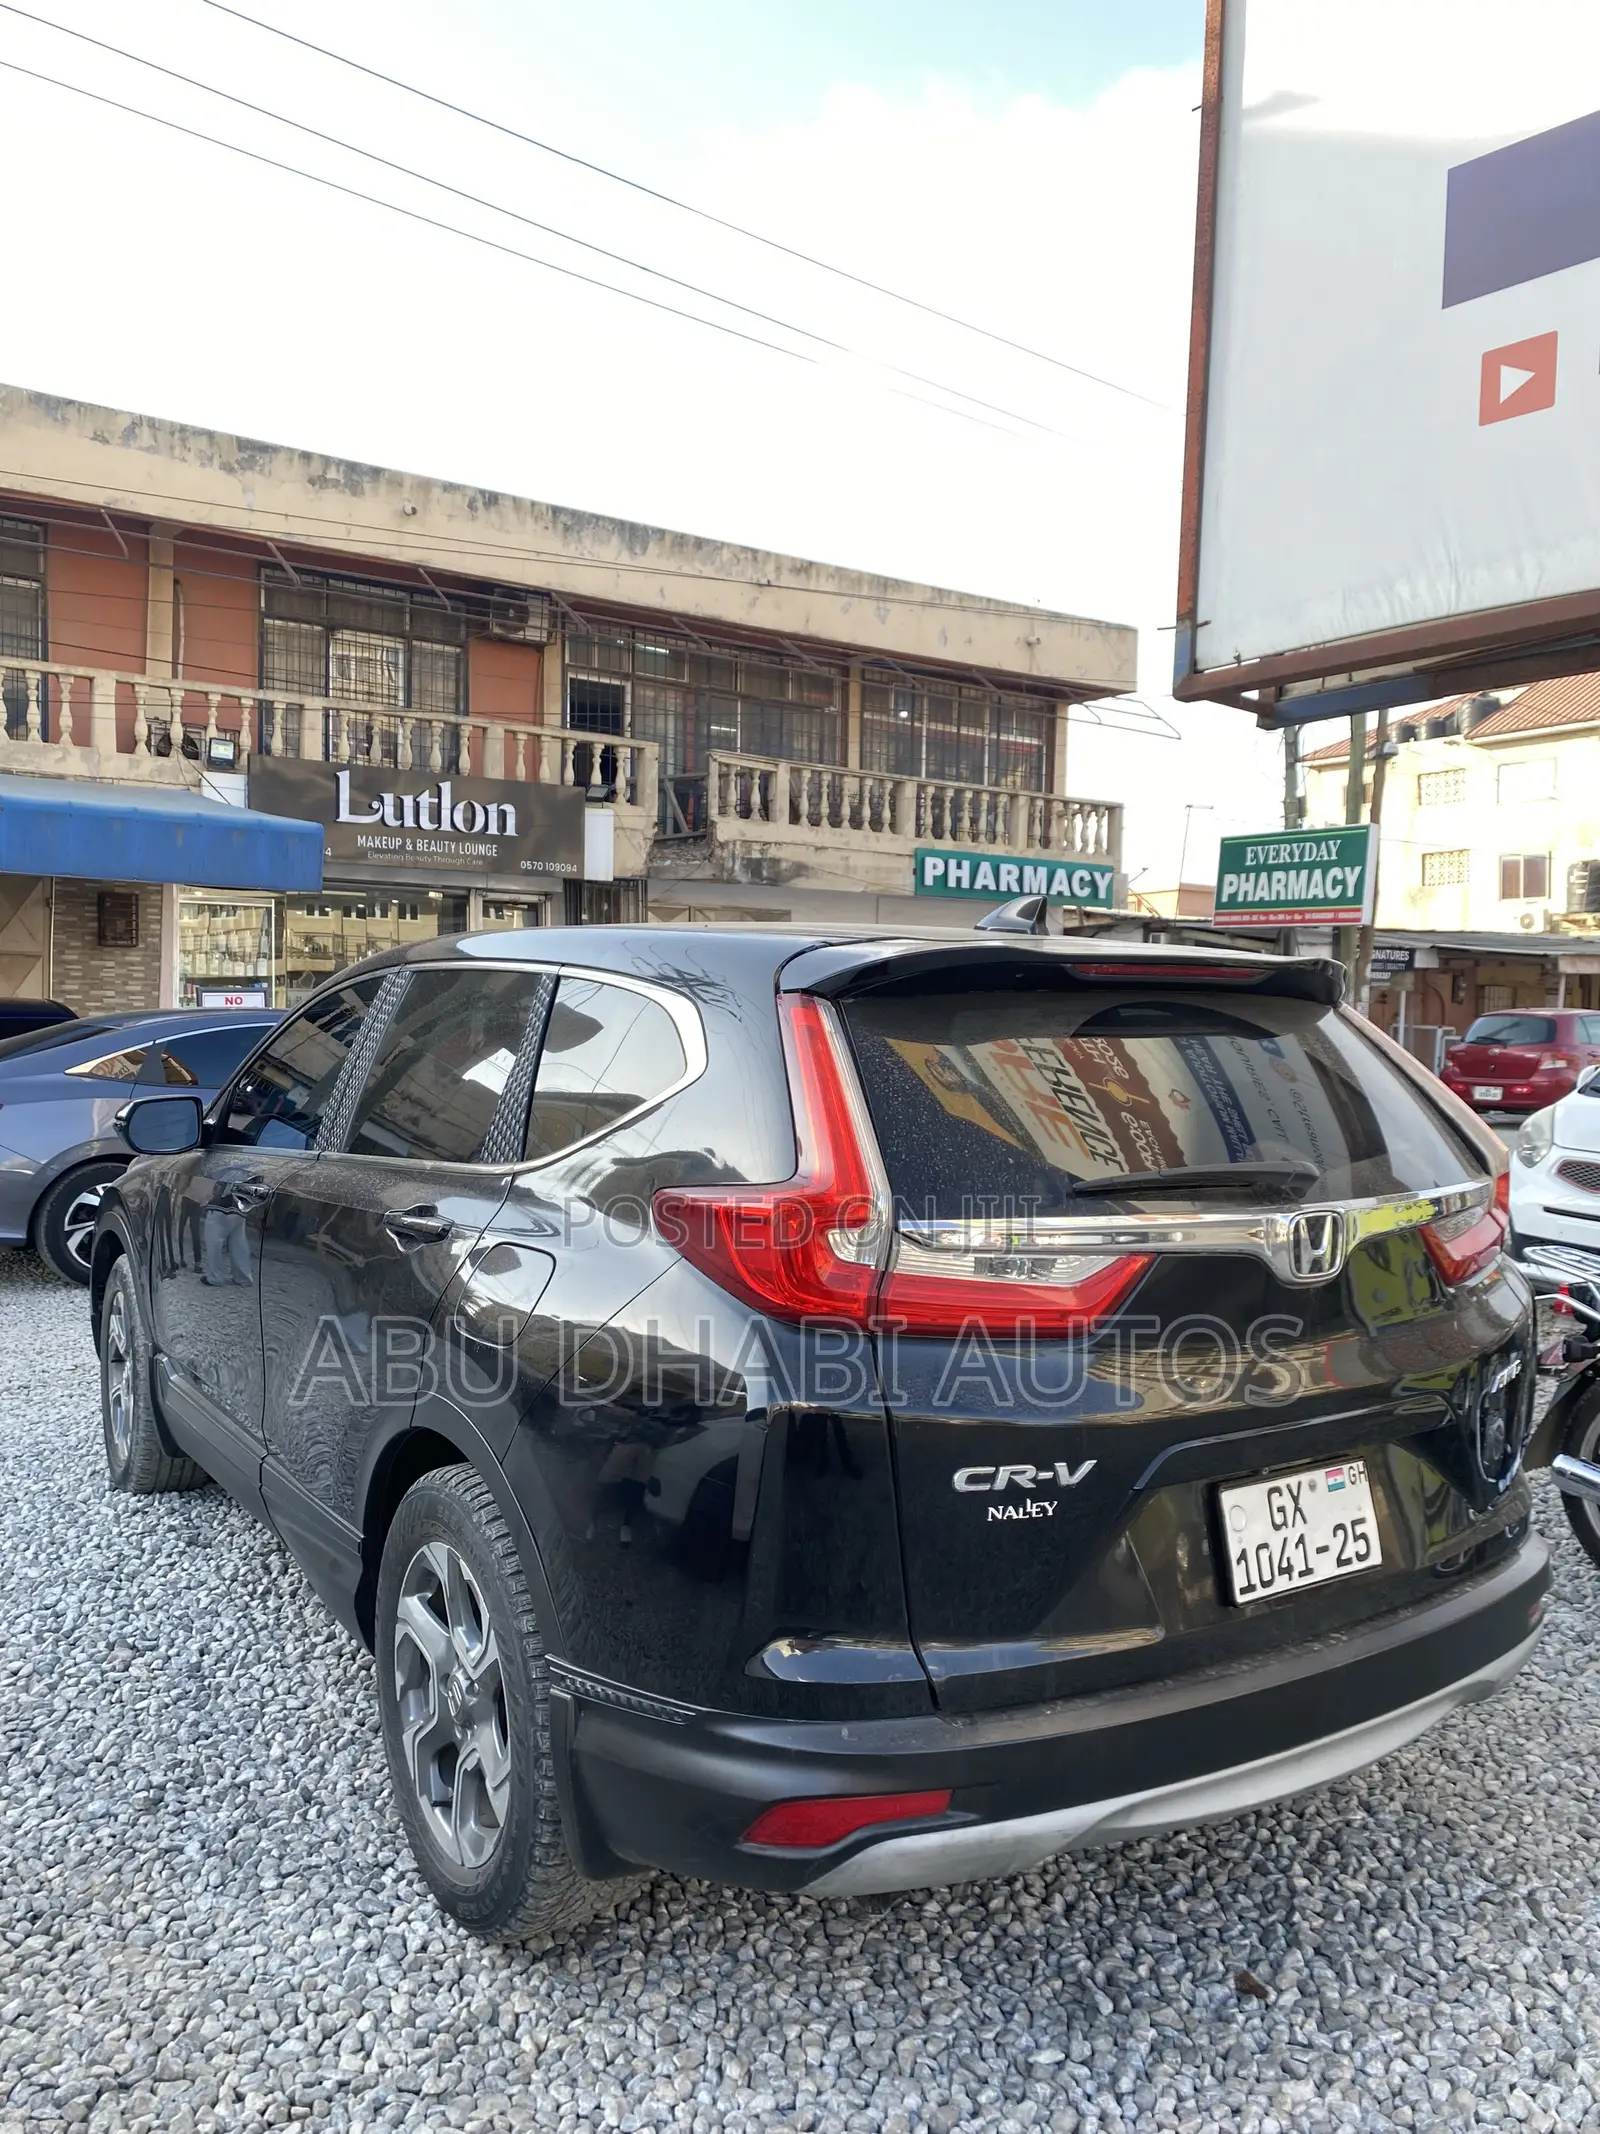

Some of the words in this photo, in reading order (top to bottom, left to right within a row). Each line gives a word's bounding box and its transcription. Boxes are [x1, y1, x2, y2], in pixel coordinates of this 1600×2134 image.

[335, 770, 519, 837] Lutlon
[357, 834, 402, 850] MAKEUP
[405, 838, 414, 851] &
[416, 839, 456, 853] BEAUTY
[459, 842, 498, 857] LOUNGE
[367, 851, 404, 862] Elevating
[405, 853, 432, 863] Beauty
[433, 855, 465, 866] Through
[466, 858, 484, 866] Care
[1245, 840, 1341, 866] EVERYDAY
[923, 856, 1113, 899] PHARMACY
[1221, 866, 1362, 903] PHARMACY
[225, 996, 243, 1006] NO
[952, 1459, 1098, 1493] CR-V
[987, 1498, 1058, 1522] NALLEY
[1267, 1480, 1308, 1532] GX
[1347, 1462, 1369, 1486] GH
[1236, 1517, 1371, 1596] 1041-25
